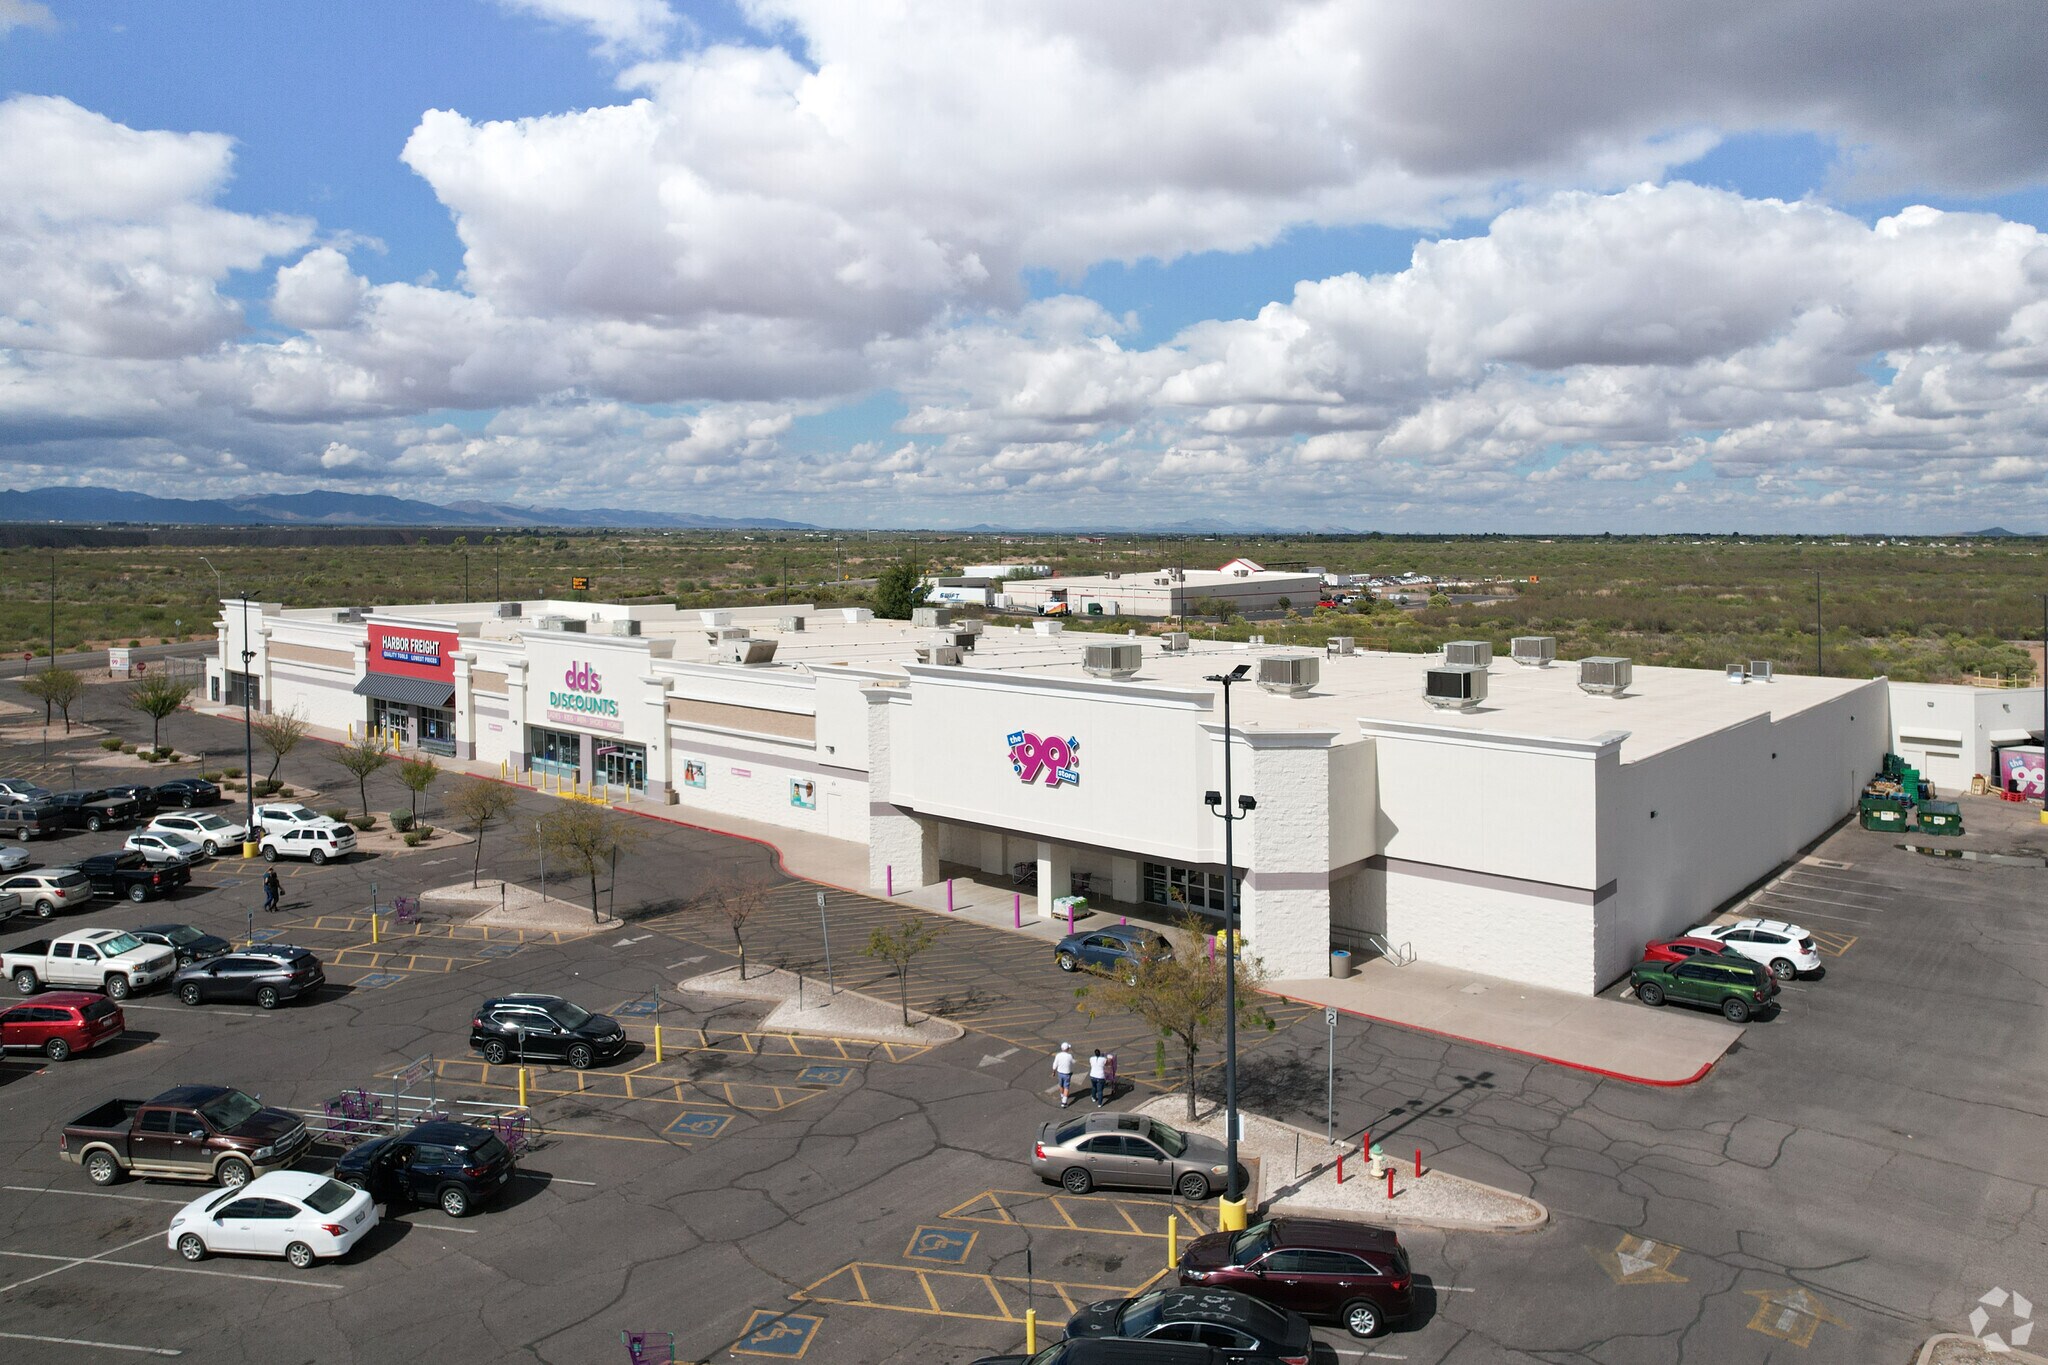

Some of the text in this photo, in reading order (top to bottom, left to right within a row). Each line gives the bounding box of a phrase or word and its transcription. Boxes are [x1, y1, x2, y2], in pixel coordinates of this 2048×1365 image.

[382, 635, 440, 655] HARBOR FREIGHT
[397, 652, 409, 660] TOOLS
[411, 654, 425, 662] LOWEST
[425, 656, 438, 664] PRICES
[565, 660, 600, 692] dd's
[550, 691, 617, 715] DISCOUNTS
[1009, 735, 1022, 744] the
[1016, 733, 1069, 784] 99
[2010, 758, 2024, 767] the
[1058, 769, 1076, 780] store
[2011, 766, 2045, 794] 99
[1328, 1013, 1335, 1025] 2
